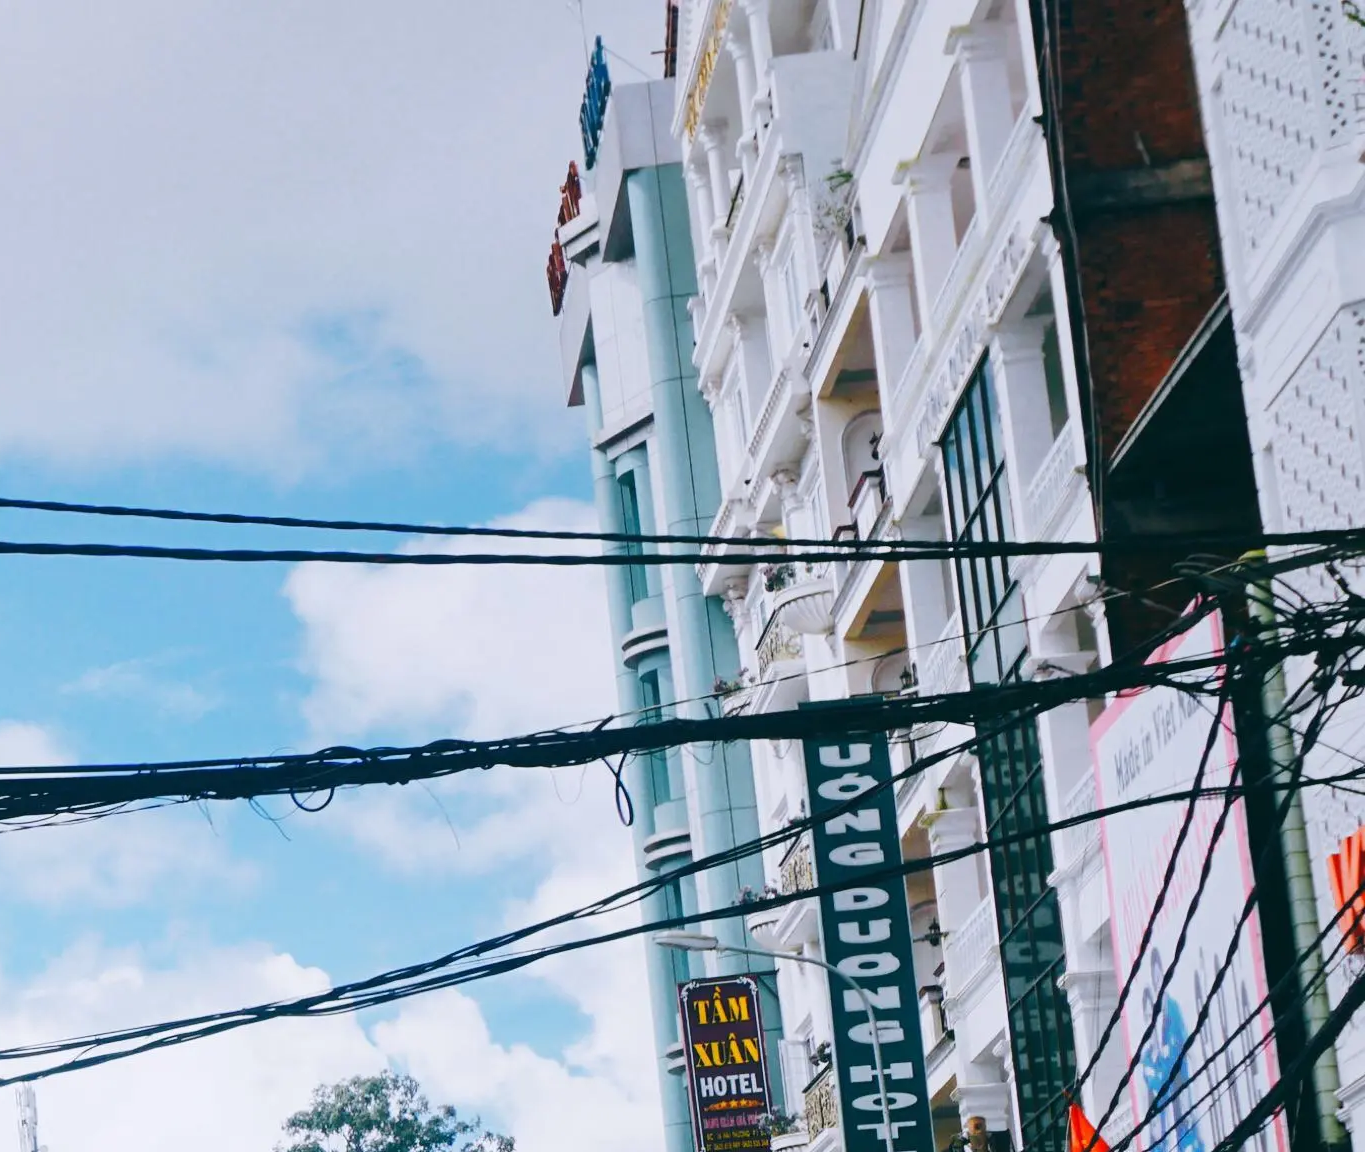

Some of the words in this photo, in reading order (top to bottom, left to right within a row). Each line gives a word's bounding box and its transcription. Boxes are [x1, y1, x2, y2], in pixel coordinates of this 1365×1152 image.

[693, 986, 750, 1025] TẦM
[693, 1033, 759, 1068] XUÂN
[700, 1073, 763, 1098] HOTEL
